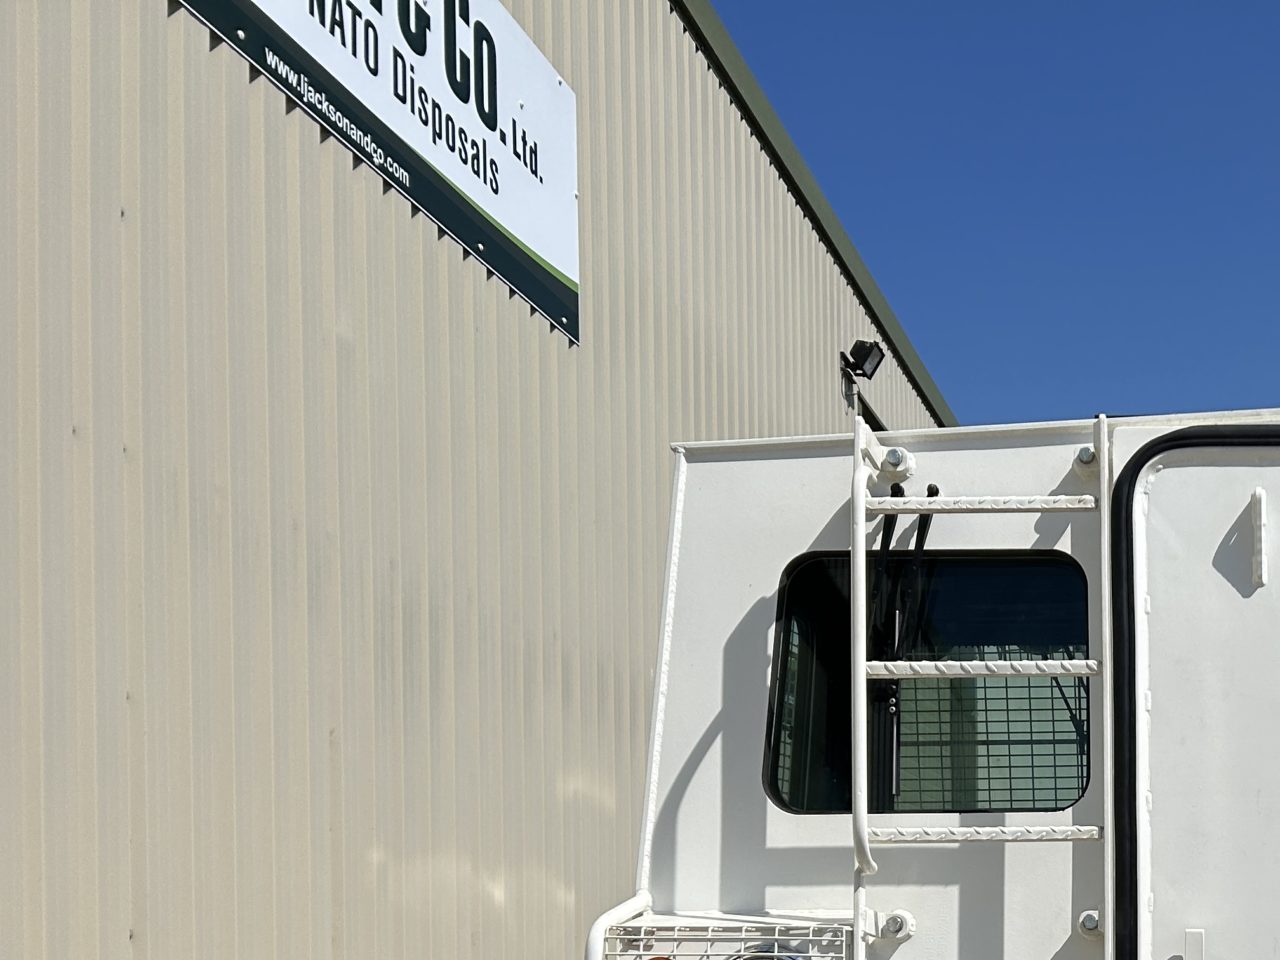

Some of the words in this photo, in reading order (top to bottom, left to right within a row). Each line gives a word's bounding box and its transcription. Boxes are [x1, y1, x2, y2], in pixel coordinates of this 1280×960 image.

[264, 46, 410, 188] www.ljacksonandco.com
[392, 45, 499, 196] Disposals
[512, 117, 544, 185] Ltd.
